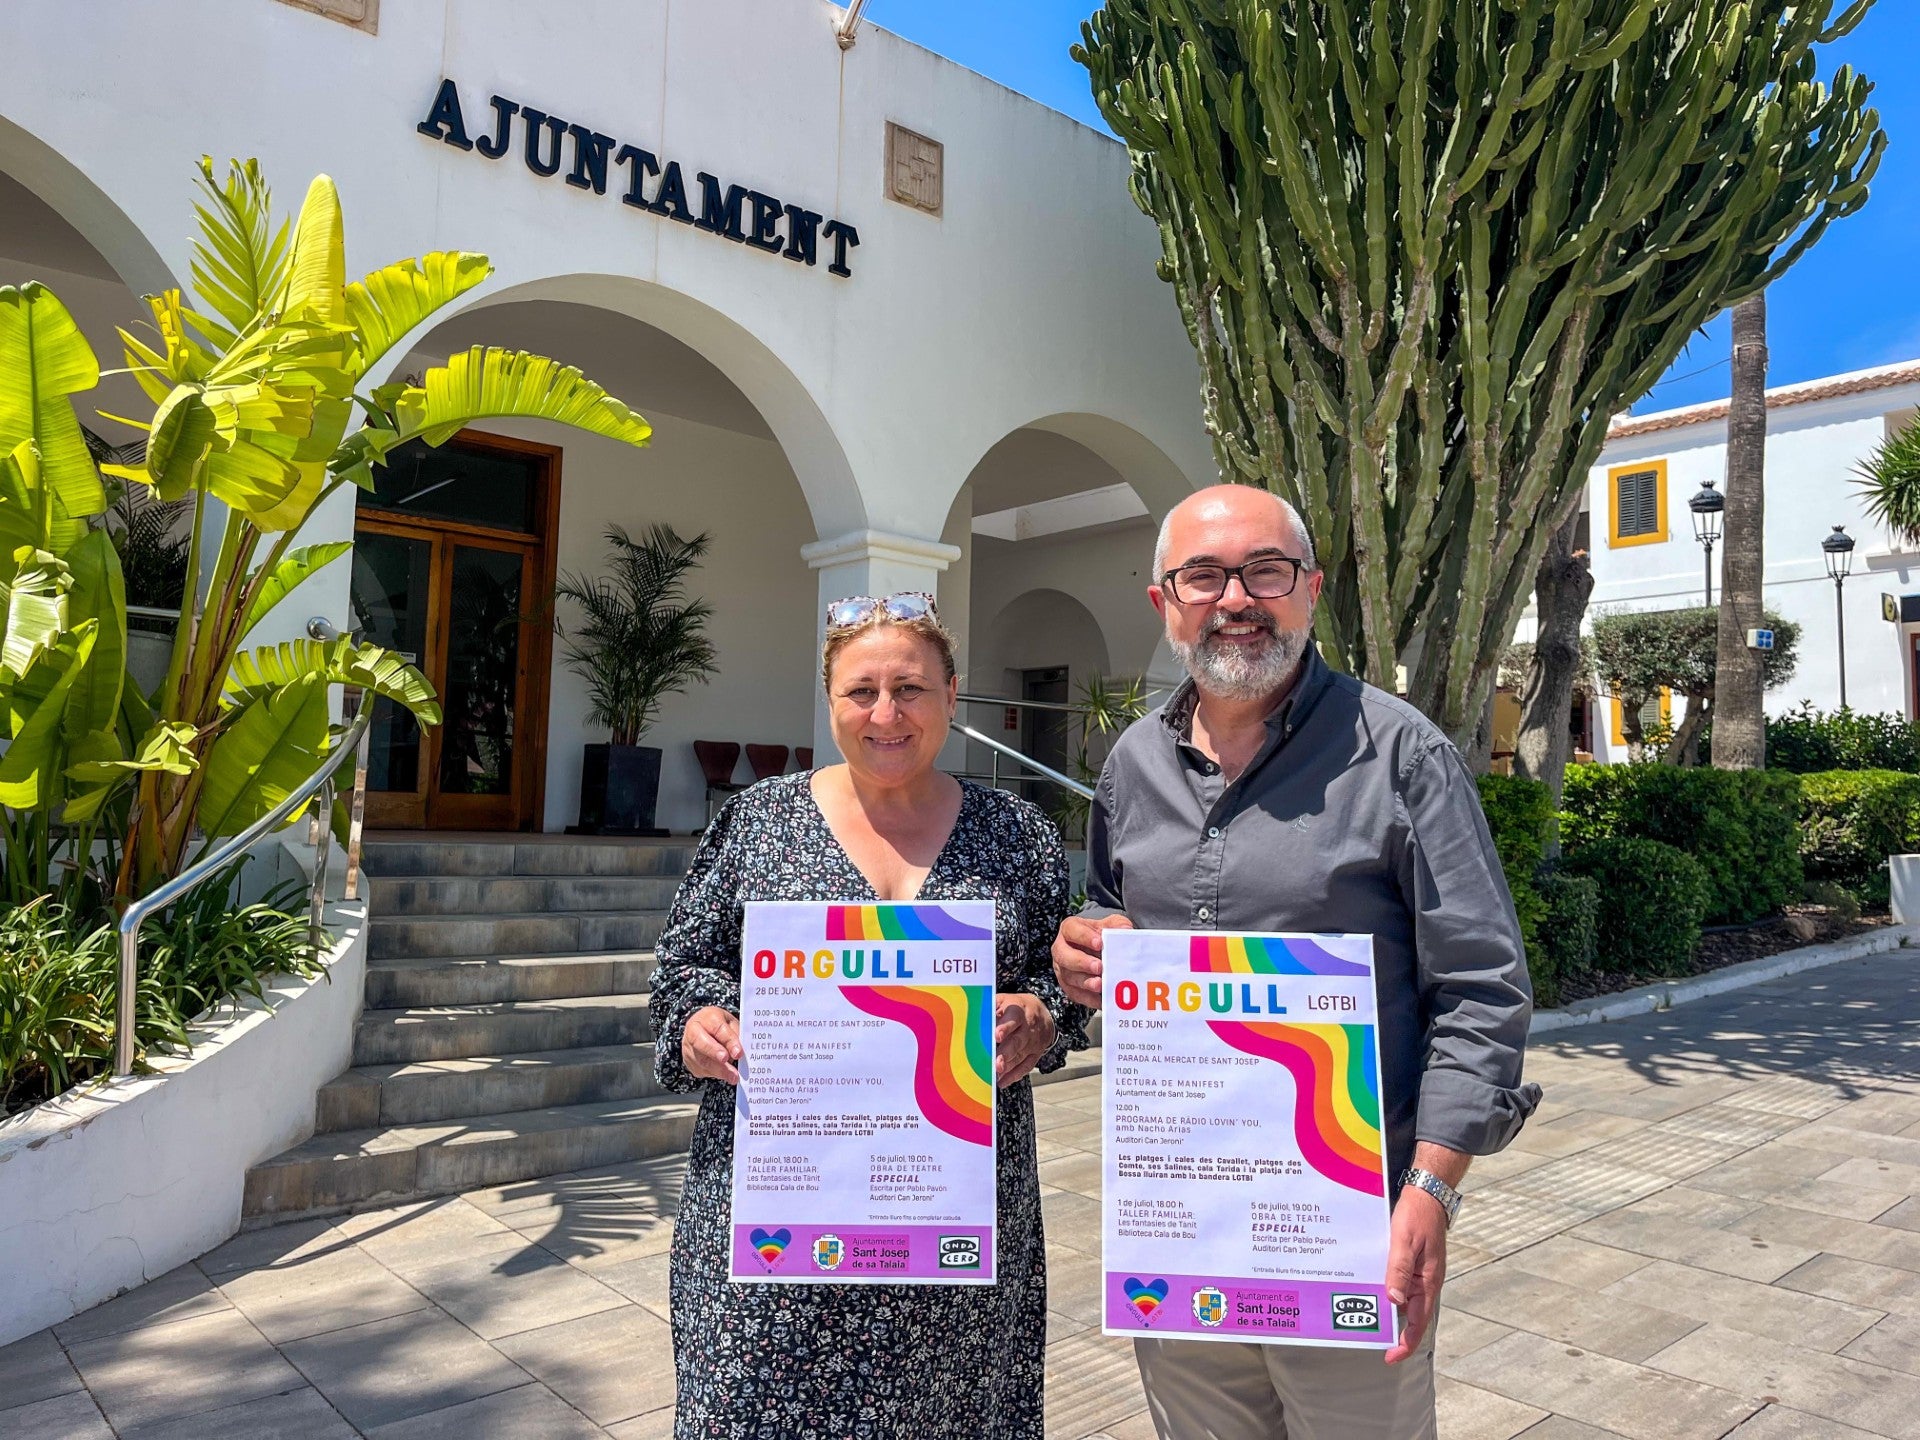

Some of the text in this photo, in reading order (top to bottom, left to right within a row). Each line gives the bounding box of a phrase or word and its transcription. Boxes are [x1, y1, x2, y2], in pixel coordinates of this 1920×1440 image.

[417, 79, 860, 277] AJUNTAMENT
[754, 950, 977, 979] ORGULL LGTBI
[756, 987, 803, 995] 28 DE JUNY
[1115, 980, 1356, 1014] ORGULL LGTBI
[1118, 1020, 1168, 1029] 28 DE JUNY
[815, 1053, 833, 1061] Josep
[1164, 1056, 1196, 1064] MERCAT
[1116, 1079, 1157, 1087] LECTURA
[1177, 1080, 1224, 1088] MANIFEST
[1116, 1089, 1155, 1097] Ajuntament
[1116, 1115, 1163, 1124] PROGRAMA
[1116, 1124, 1135, 1132] amb
[1138, 1124, 1165, 1132] Nacho
[1116, 1136, 1144, 1144] Auditori
[1136, 1154, 1164, 1163] platges
[1254, 1159, 1283, 1167] platges
[1118, 1162, 1145, 1170] Comte,
[1164, 1164, 1194, 1172] Salines,
[870, 1175, 920, 1183] ESPECIAL
[1251, 1202, 1256, 1210] 5
[1315, 1204, 1320, 1212] h
[1118, 1209, 1149, 1217] TALLER
[1252, 1213, 1331, 1223] OBRA DE TEATRE
[1168, 1220, 1176, 1228] de
[1252, 1223, 1306, 1233] ESPECIAL
[1118, 1229, 1152, 1237] Biblioteca
[1154, 1230, 1170, 1238] Cala
[852, 1238, 894, 1246] Ajuntament
[1252, 1234, 1277, 1243] Escrita
[1293, 1236, 1313, 1244] Pablo
[945, 1242, 974, 1250] ONDA
[1252, 1245, 1282, 1253] Auditori
[852, 1247, 910, 1259] Sant Josep
[946, 1254, 973, 1263] CERO
[852, 1260, 864, 1268] de
[880, 1261, 905, 1269] Talaia
[1236, 1292, 1295, 1302] Ajuntament de
[1237, 1303, 1300, 1317] Sant Josep
[1339, 1301, 1371, 1310] ONDA
[1237, 1316, 1295, 1328] de sa Talaia
[1342, 1315, 1371, 1324] CERO
